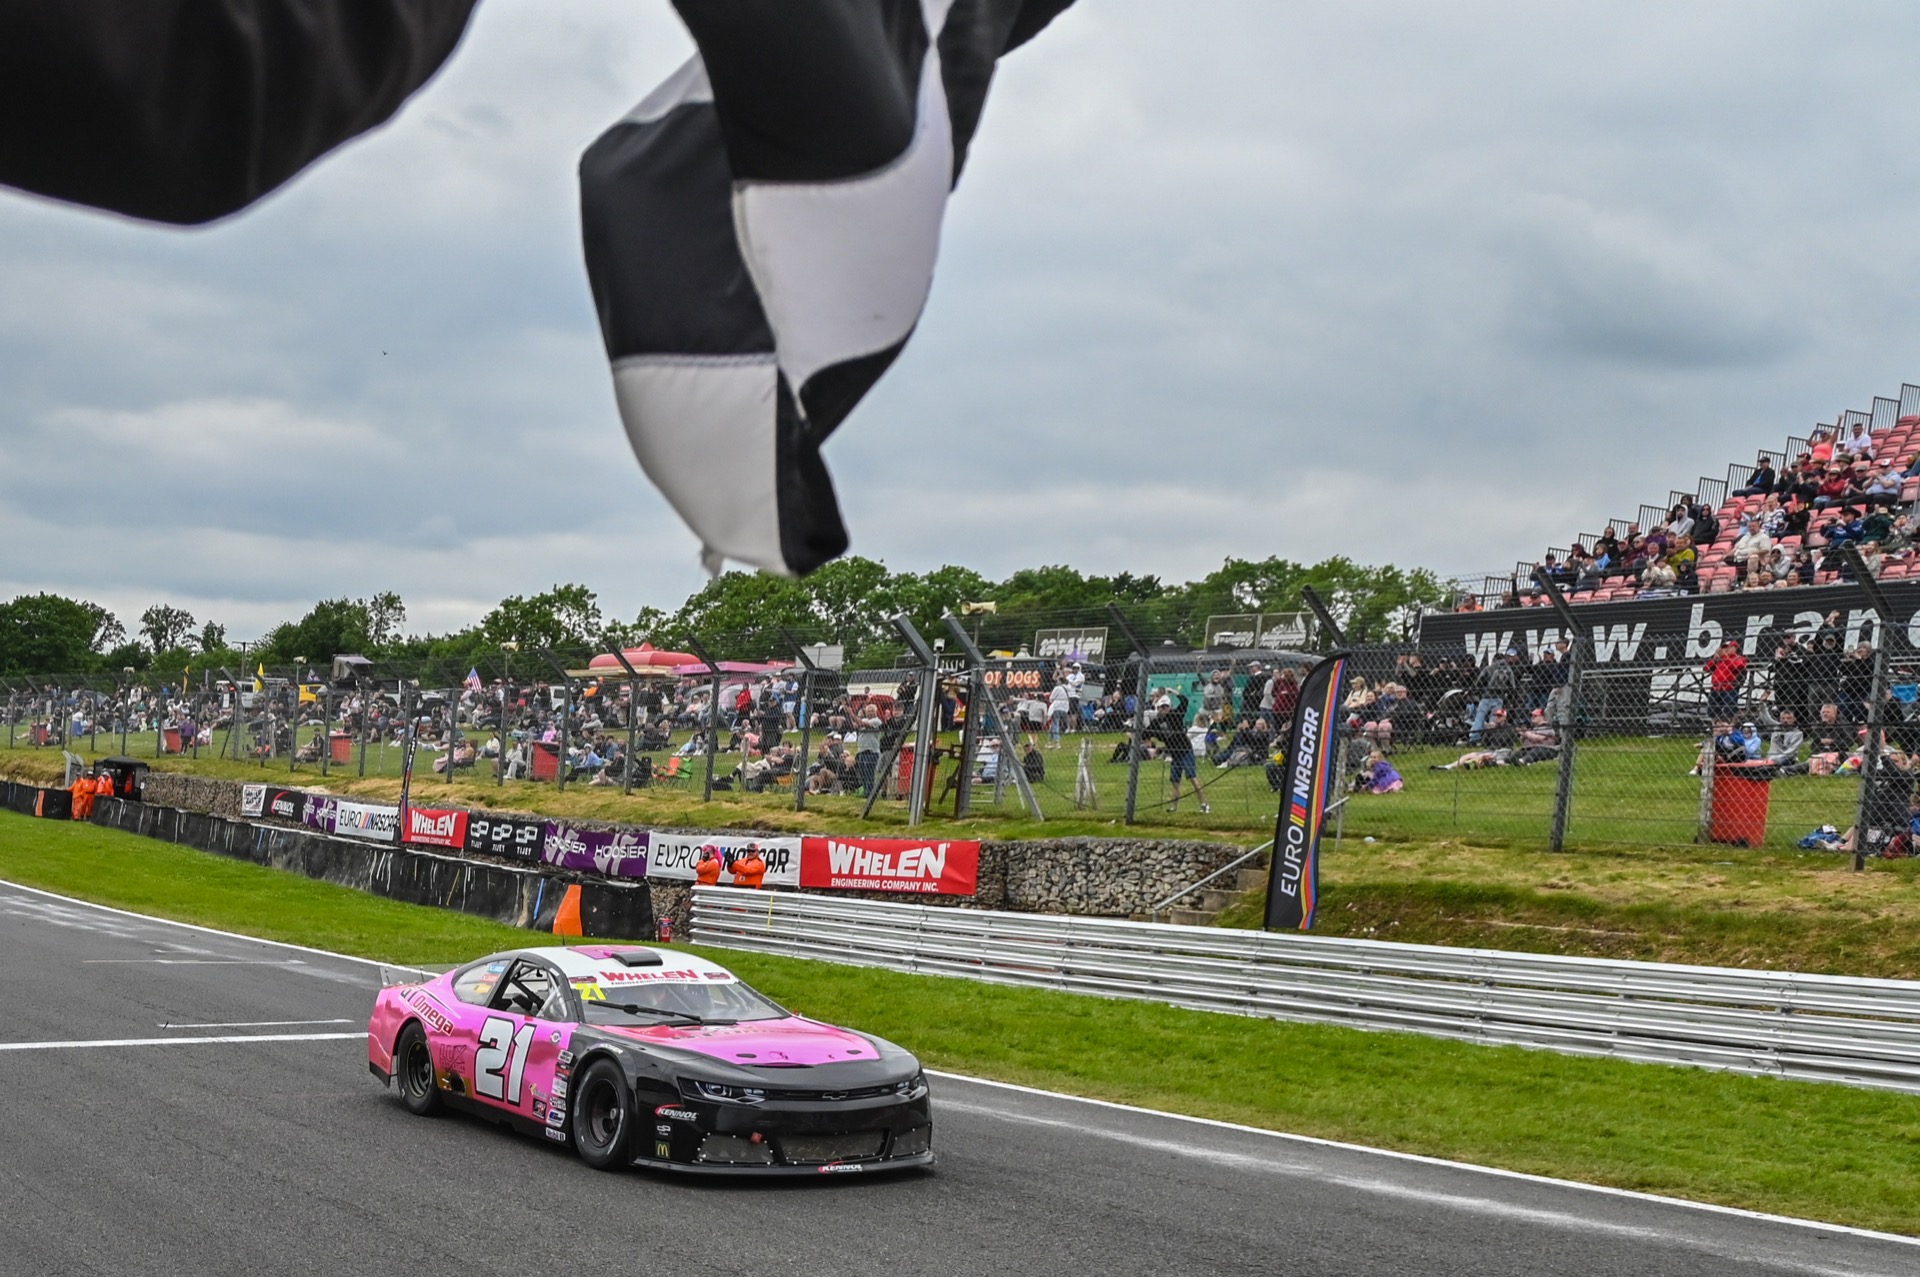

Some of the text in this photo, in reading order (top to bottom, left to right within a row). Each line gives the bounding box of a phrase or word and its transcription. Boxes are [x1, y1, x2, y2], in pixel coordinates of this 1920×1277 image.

[1006, 670, 1041, 688] DOGS
[1281, 707, 1320, 897] EURO NASCAR
[339, 808, 362, 829] EURO
[411, 809, 458, 837] WHELEN
[544, 833, 587, 855] HOOSIER
[595, 842, 647, 863] HOOSIER
[828, 840, 947, 879] WHELEN
[831, 877, 939, 893] ENGINEERING COMPANY INC.
[600, 969, 699, 982] WHELEN
[575, 982, 607, 1000] 21
[412, 993, 455, 1035] Omega
[474, 1015, 538, 1107] 21
[657, 1107, 699, 1120] KENNOL
[822, 1163, 863, 1172] KENNOL
